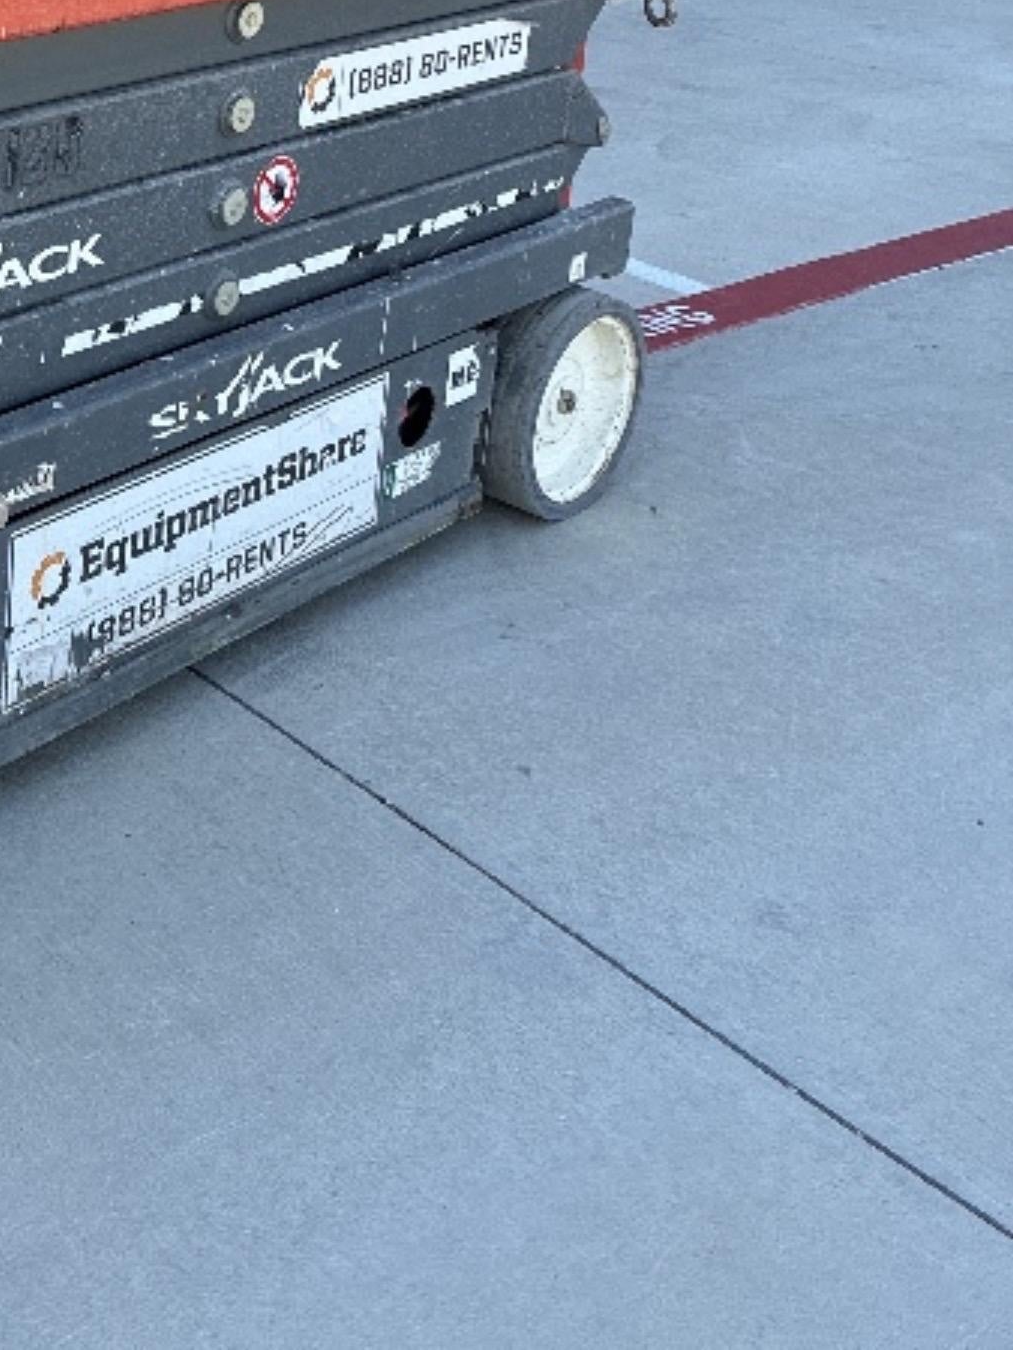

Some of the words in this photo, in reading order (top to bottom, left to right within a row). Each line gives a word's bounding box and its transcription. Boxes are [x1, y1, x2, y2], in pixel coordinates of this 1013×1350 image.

[349, 56, 412, 100] (888)
[418, 30, 522, 79] 80-RENTS
[79, 426, 368, 583] EquipmentShare
[178, 521, 308, 607] 80-RENTS
